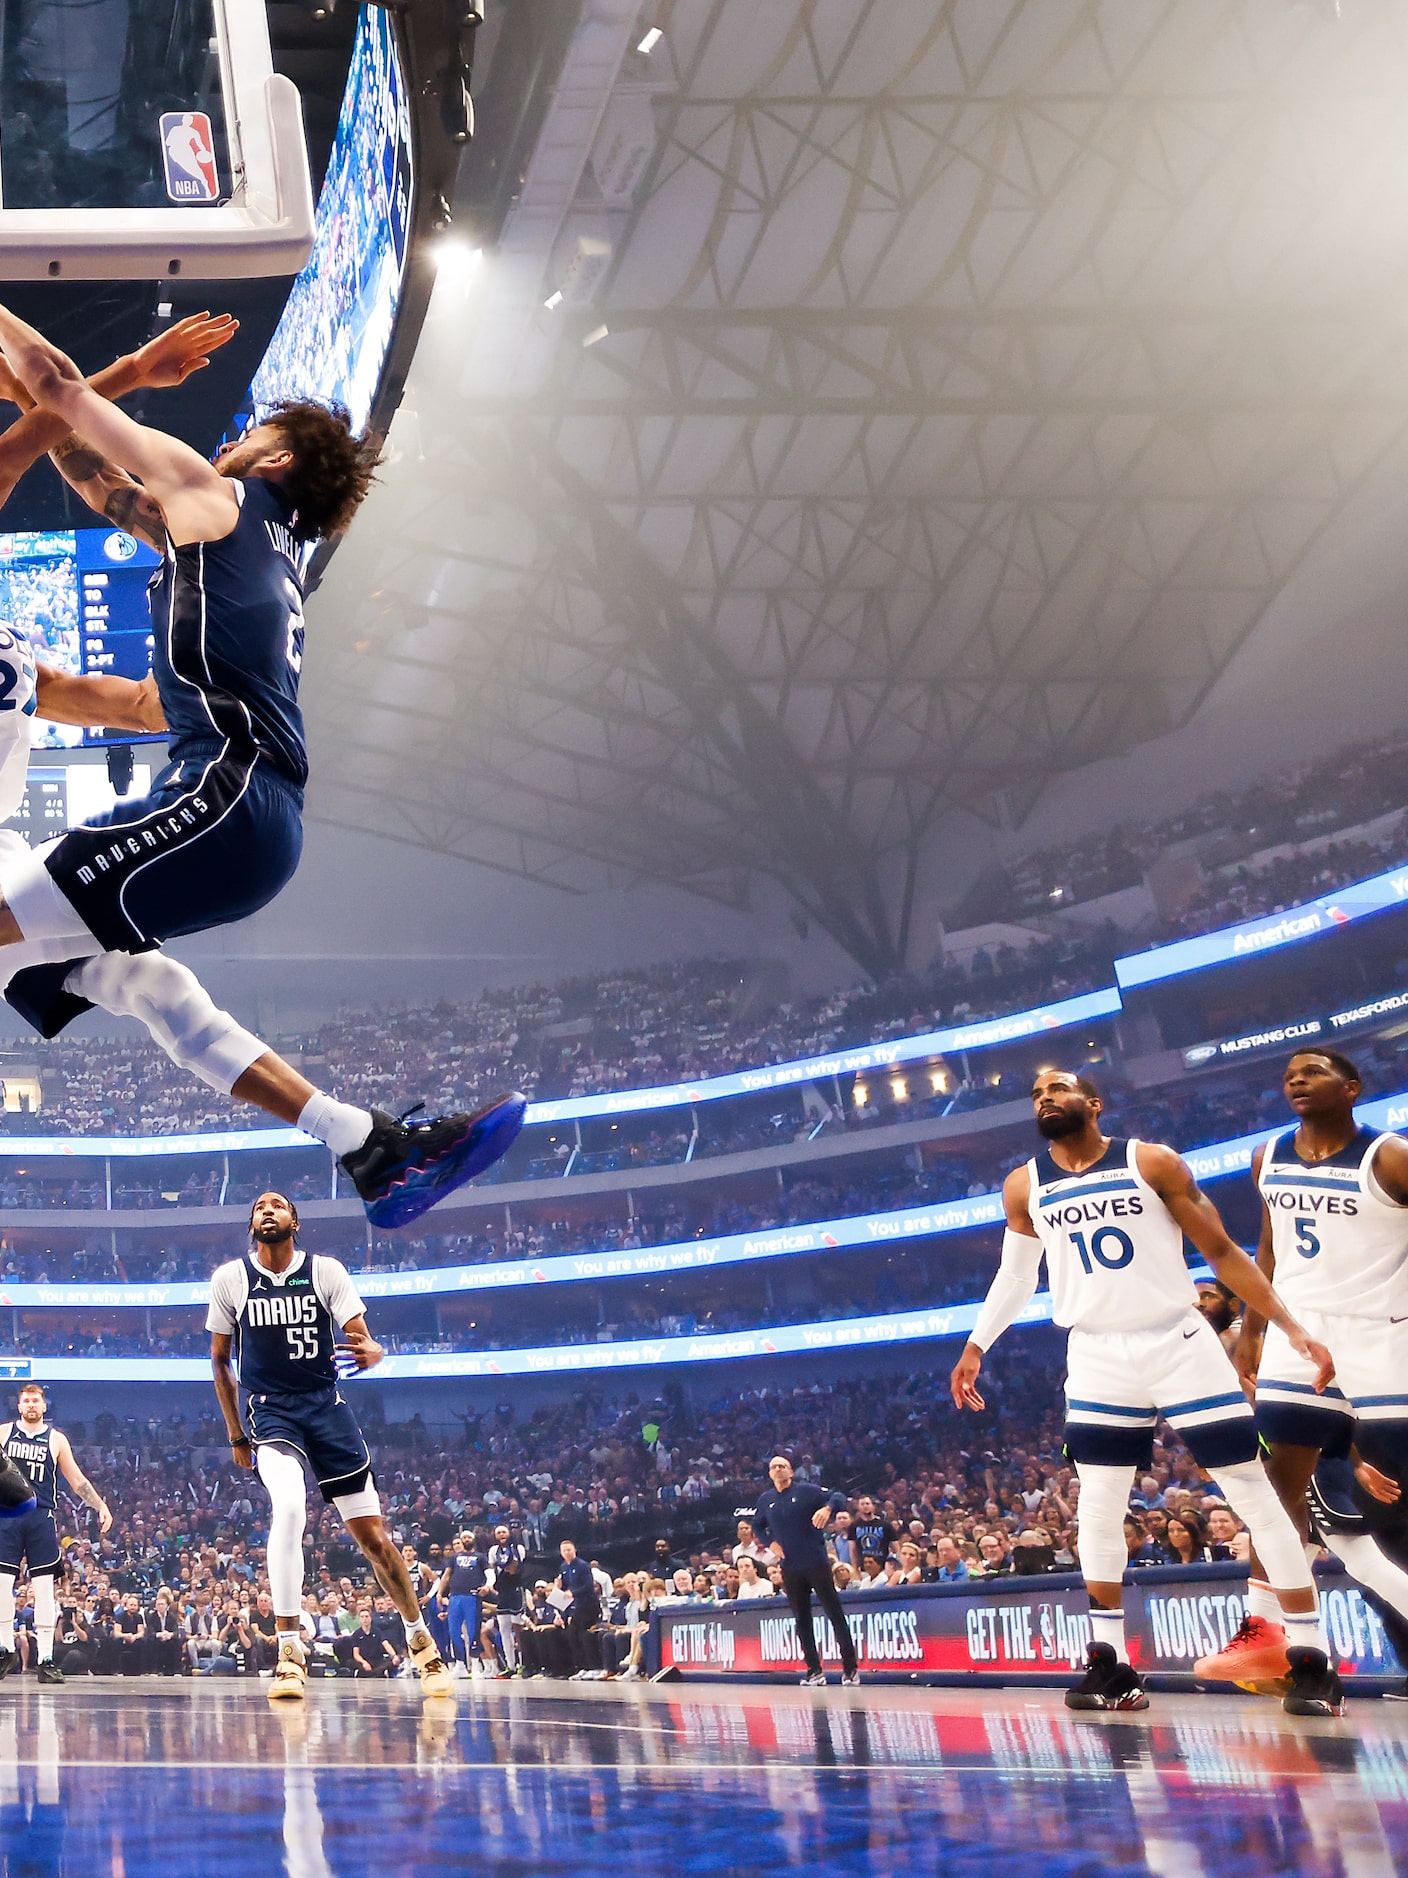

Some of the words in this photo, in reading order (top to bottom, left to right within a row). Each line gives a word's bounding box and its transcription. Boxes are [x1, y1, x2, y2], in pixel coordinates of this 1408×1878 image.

[175, 181, 200, 195] NBA
[85, 589, 102, 600] TO
[85, 605, 109, 617] BLK
[86, 620, 107, 631] STL
[76, 797, 209, 885] MAVERICKS
[1233, 912, 1321, 952] American
[953, 1018, 1033, 1047] American
[1220, 1028, 1284, 1054] MUSTANG
[1285, 1021, 1321, 1040] CLUB
[607, 1092, 679, 1112] American
[1043, 1196, 1143, 1229] WOLVES
[1265, 1191, 1358, 1216] WOLVES
[867, 1218, 900, 1237] You
[903, 1215, 930, 1231] are
[933, 1209, 969, 1229] why
[972, 1204, 996, 1220] we
[743, 1233, 814, 1255] American
[1068, 1226, 1134, 1274] 10
[1295, 1217, 1320, 1259] 5
[574, 1260, 603, 1275] You
[607, 1260, 632, 1272] are
[635, 1253, 666, 1271] why
[669, 1251, 693, 1264] we
[357, 1279, 386, 1296] why
[388, 1279, 411, 1291] we
[459, 1268, 524, 1285] American
[37, 1289, 63, 1303] You
[67, 1293, 89, 1303] are
[92, 1290, 121, 1306] why
[123, 1292, 145, 1303] we
[247, 1294, 318, 1327] MAVS
[803, 1330, 832, 1345] You
[836, 1326, 860, 1340] are
[863, 1323, 896, 1340] why
[899, 1318, 924, 1333] we
[286, 1328, 319, 1360] 55
[688, 1339, 755, 1357] American
[416, 1358, 480, 1373] American
[527, 1354, 554, 1369] You
[7, 1441, 48, 1462] MAVS
[26, 1461, 45, 1482] 77
[855, 1526, 885, 1539] DALLAS
[671, 1623, 689, 1663] GET
[689, 1623, 707, 1662] THE
[717, 1622, 736, 1669] App
[867, 1610, 923, 1660] ACCESS.
[966, 1607, 998, 1661] GET
[1000, 1606, 1035, 1660] THE
[1056, 1605, 1091, 1667] App
